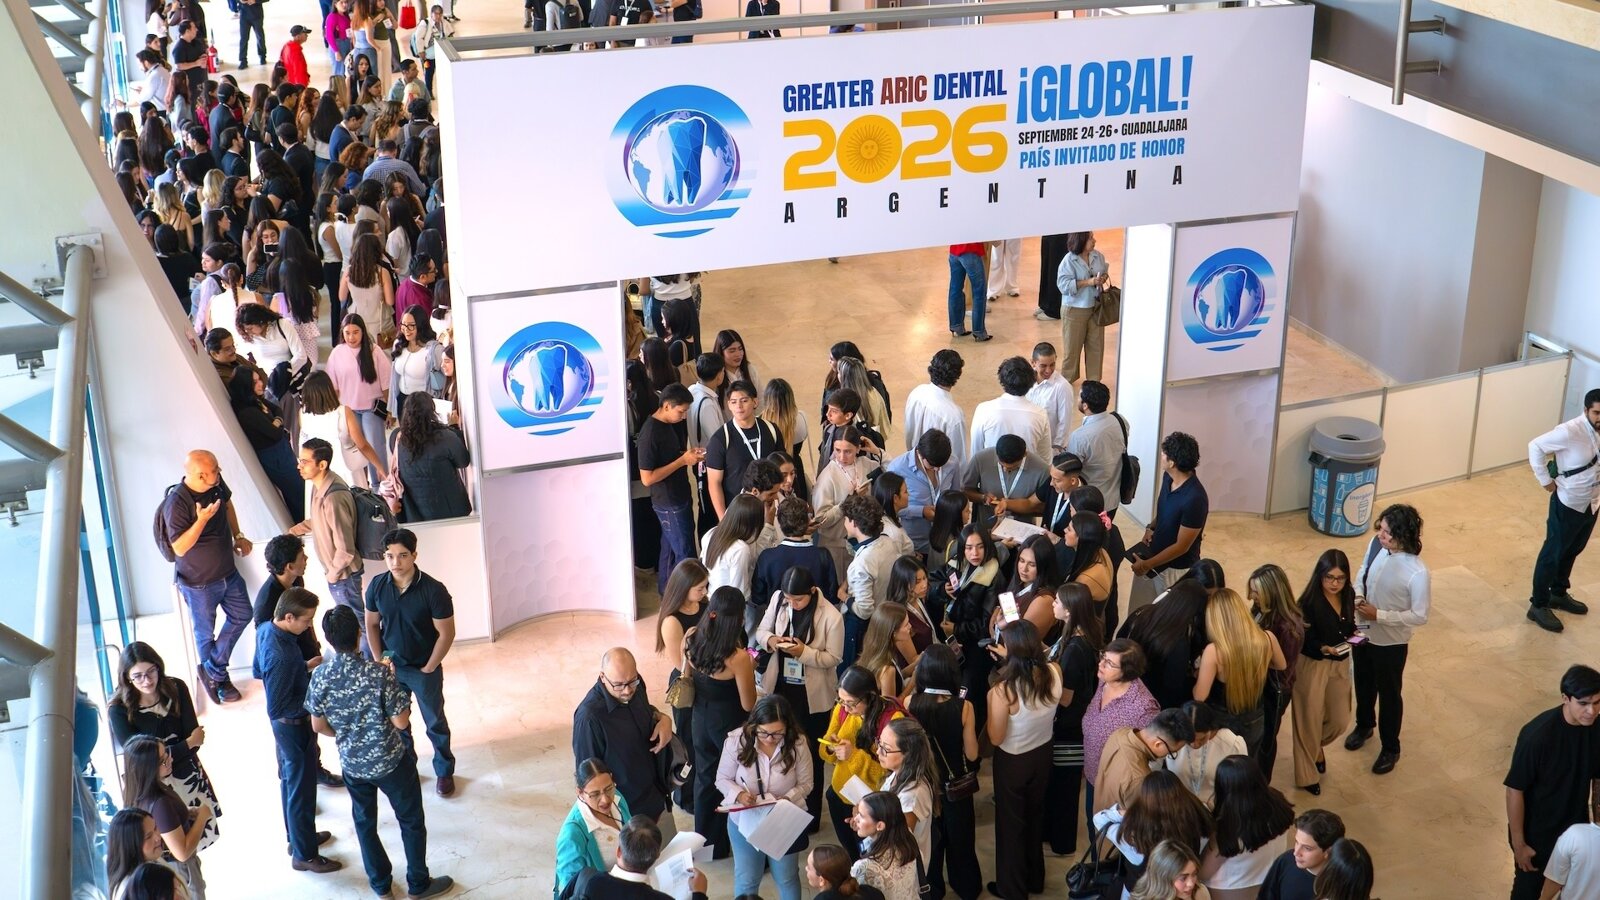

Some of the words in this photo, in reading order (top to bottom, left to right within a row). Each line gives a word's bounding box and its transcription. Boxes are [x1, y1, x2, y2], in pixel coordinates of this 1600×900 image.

[783, 82, 874, 112] GREATER
[880, 75, 928, 105] ARIC
[934, 69, 1008, 101] DENTAL
[1017, 56, 1193, 125] ¡GLOBAL!
[783, 104, 1008, 191] 2026
[1018, 127, 1079, 146] SEPTIEMBRE
[1120, 118, 1188, 137] GUADALAJARA
[1019, 145, 1051, 170] PAÍS
[1054, 143, 1117, 166] INVITADO
[1119, 142, 1137, 161] DE
[1141, 138, 1186, 160] HONOR
[784, 165, 1184, 224] ARGENTINA
